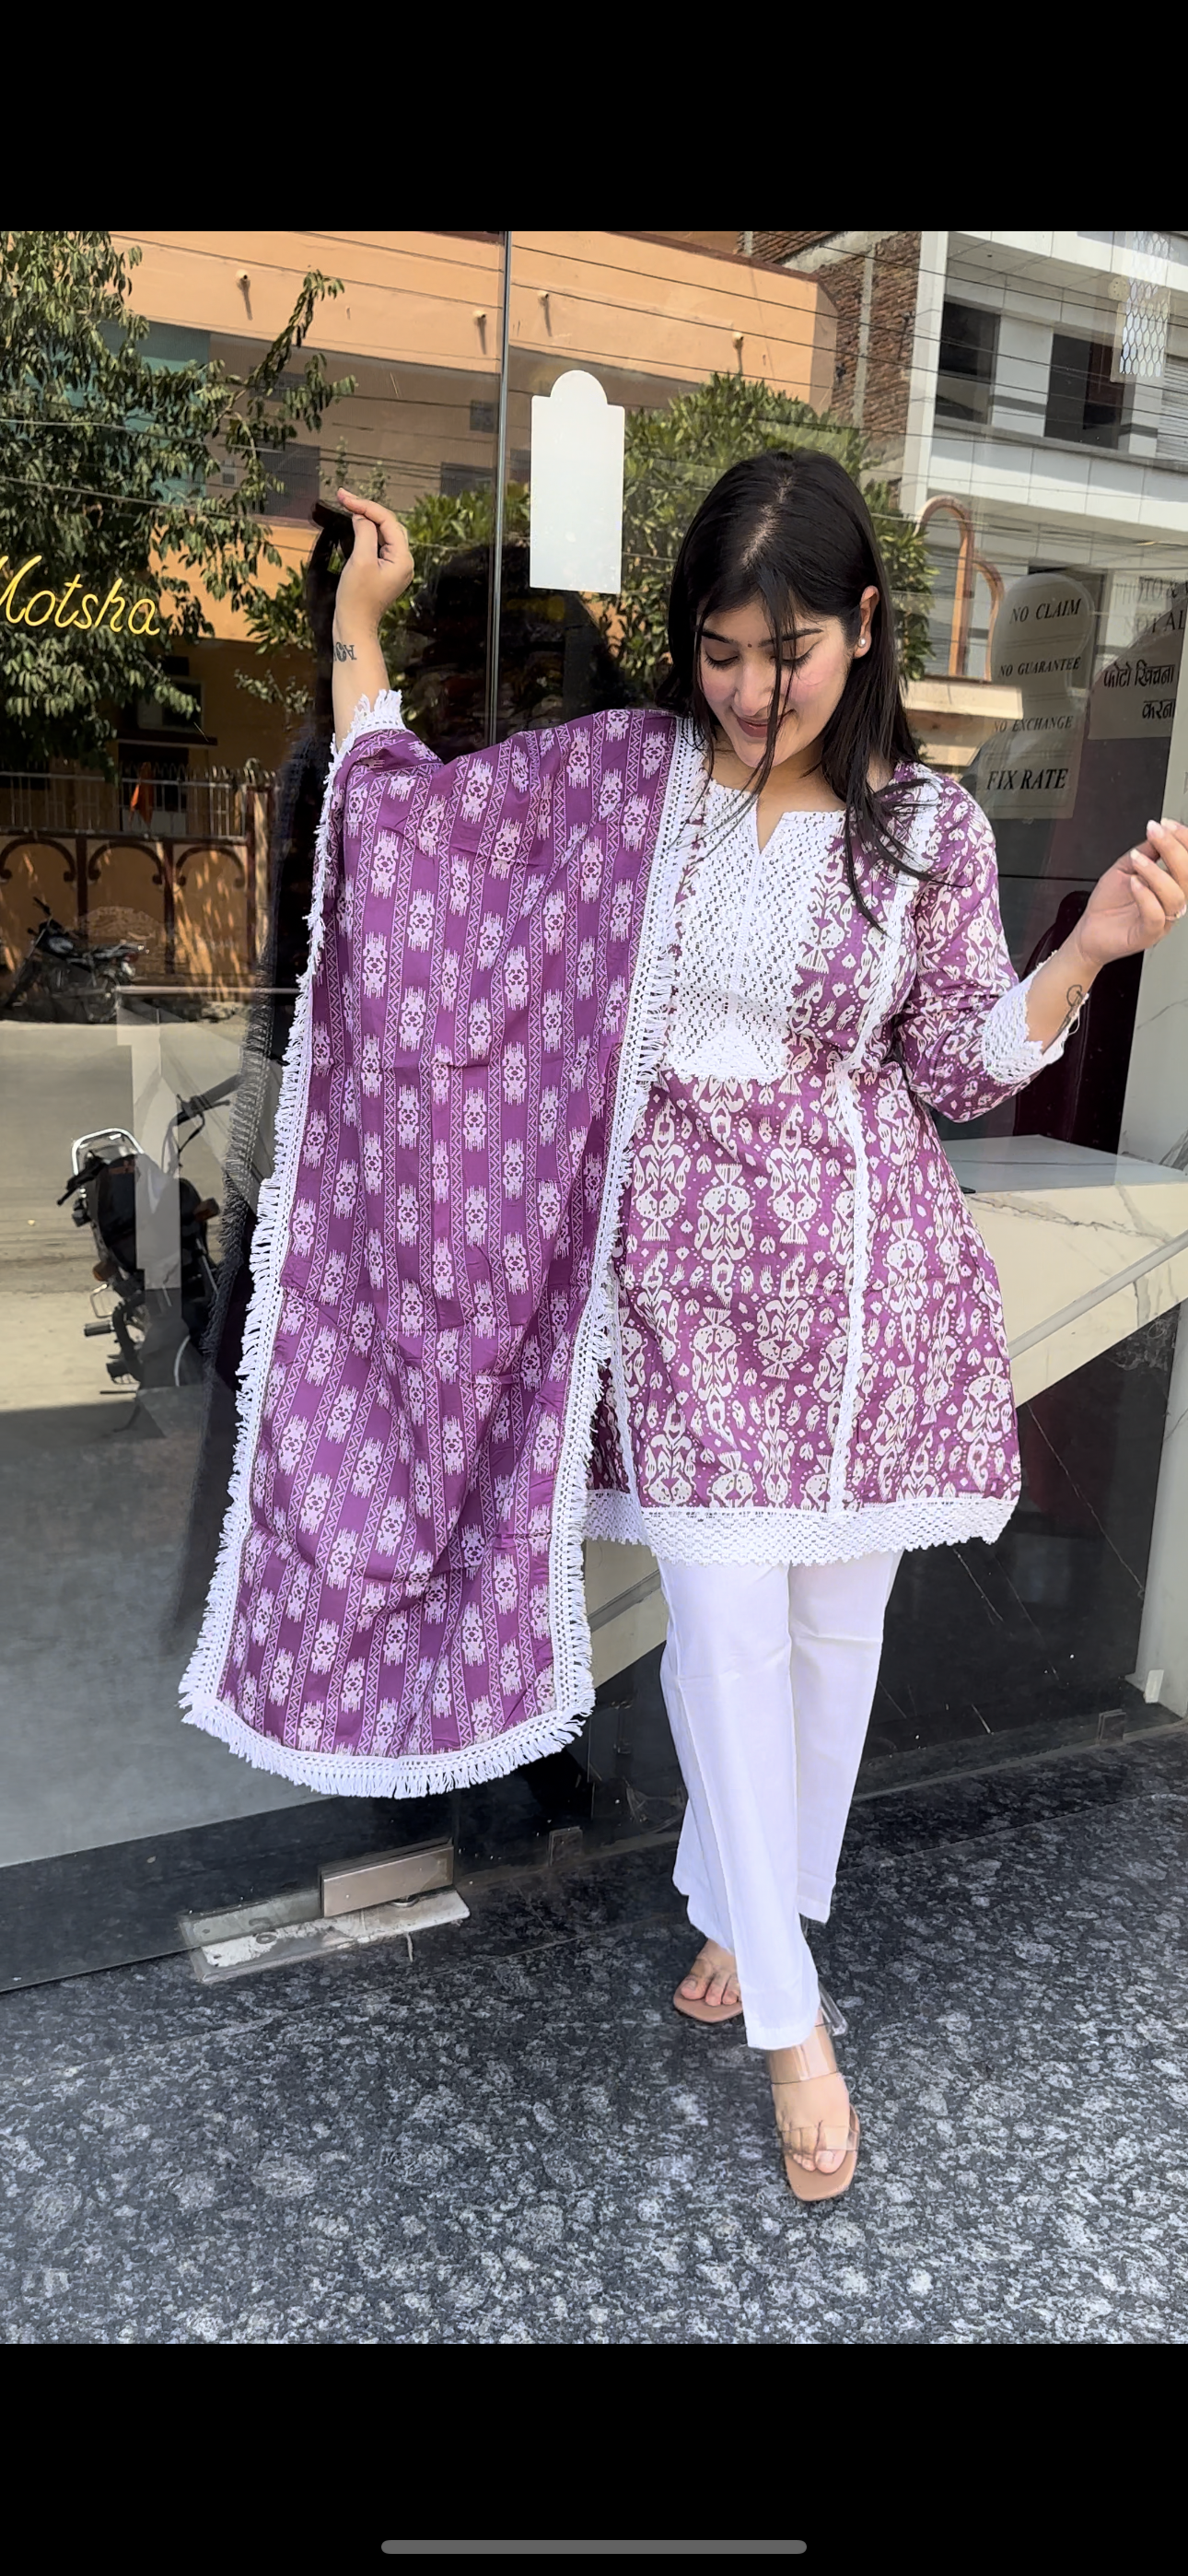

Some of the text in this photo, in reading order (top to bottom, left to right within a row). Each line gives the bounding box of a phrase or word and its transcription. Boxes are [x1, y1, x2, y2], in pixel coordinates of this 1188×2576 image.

[1009, 598, 1082, 625] NO CLAIM
[1164, 609, 1186, 631] AL
[997, 656, 1081, 678] NO GUARANTEE
[1103, 661, 1133, 688] फोटो
[993, 716, 1073, 733] NO EXCHANGE
[986, 767, 1068, 790] FIX RATE
